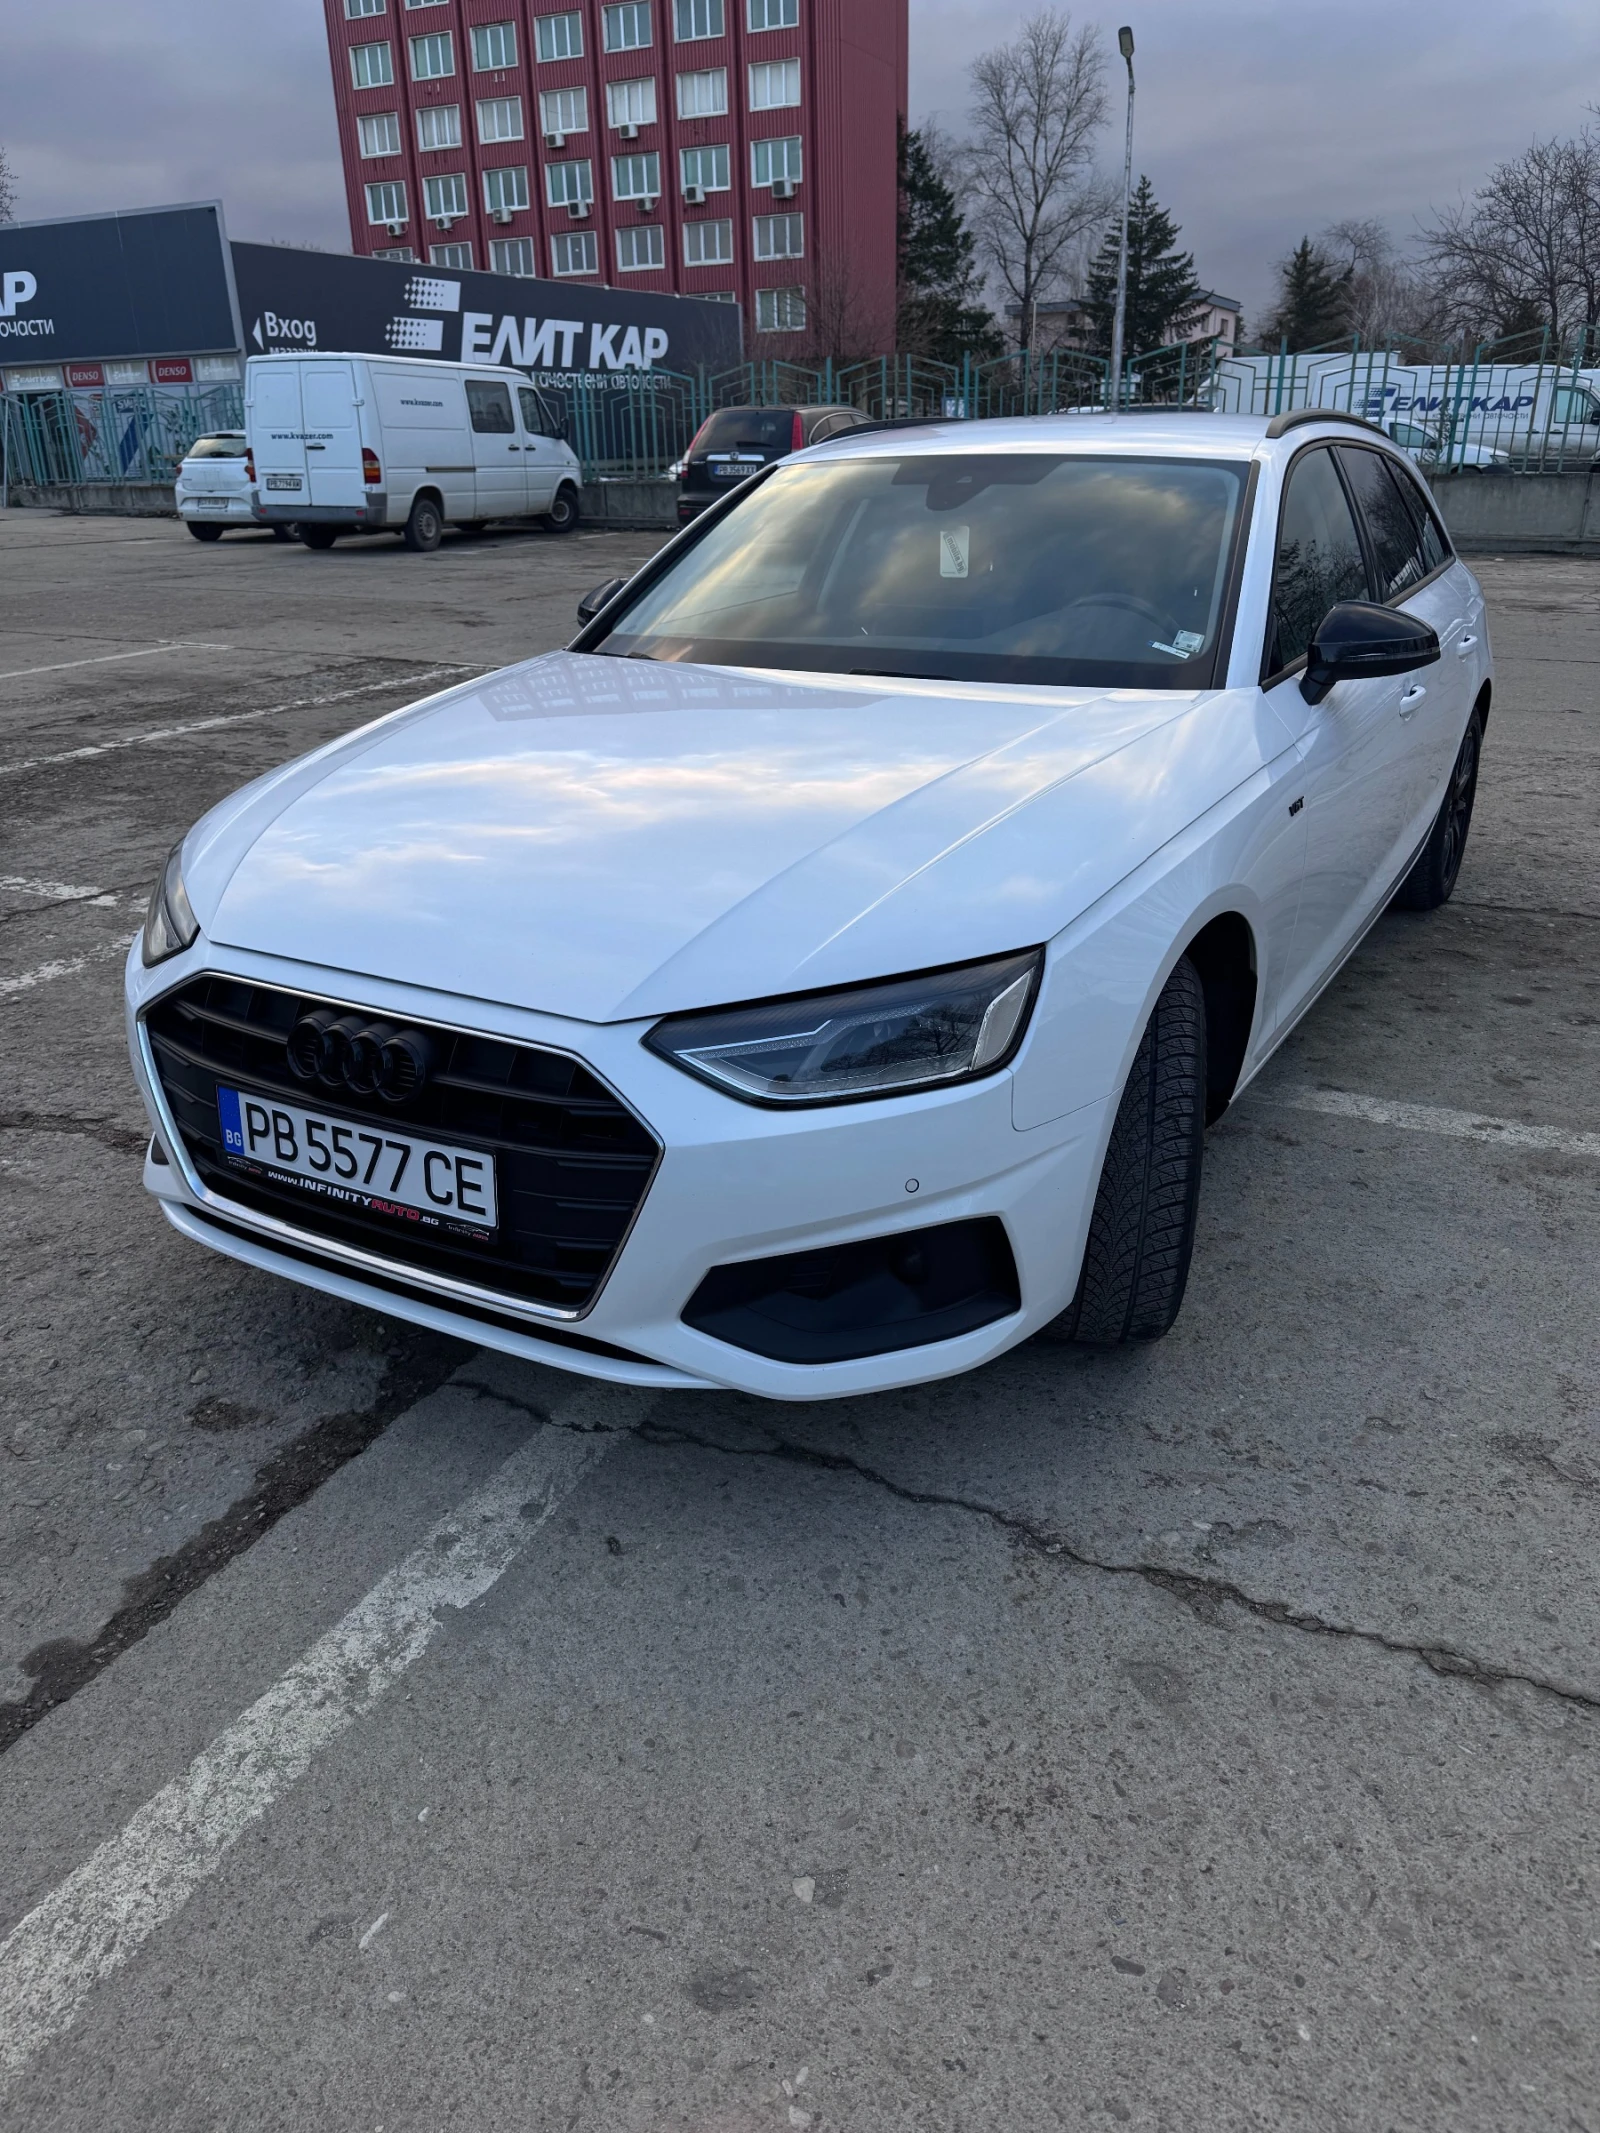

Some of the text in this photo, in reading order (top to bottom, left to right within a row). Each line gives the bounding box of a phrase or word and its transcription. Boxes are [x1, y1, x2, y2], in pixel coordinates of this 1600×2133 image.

[0, 270, 37, 316] Р
[264, 311, 317, 346] Вход
[461, 312, 669, 370] ЕЛИТ КАР
[72, 370, 99, 381] DENSO
[158, 366, 187, 377] DENSO
[271, 431, 334, 440] www.kvazer.com
[225, 1128, 242, 1147] BG
[245, 1101, 486, 1216] PB 5577 CE
